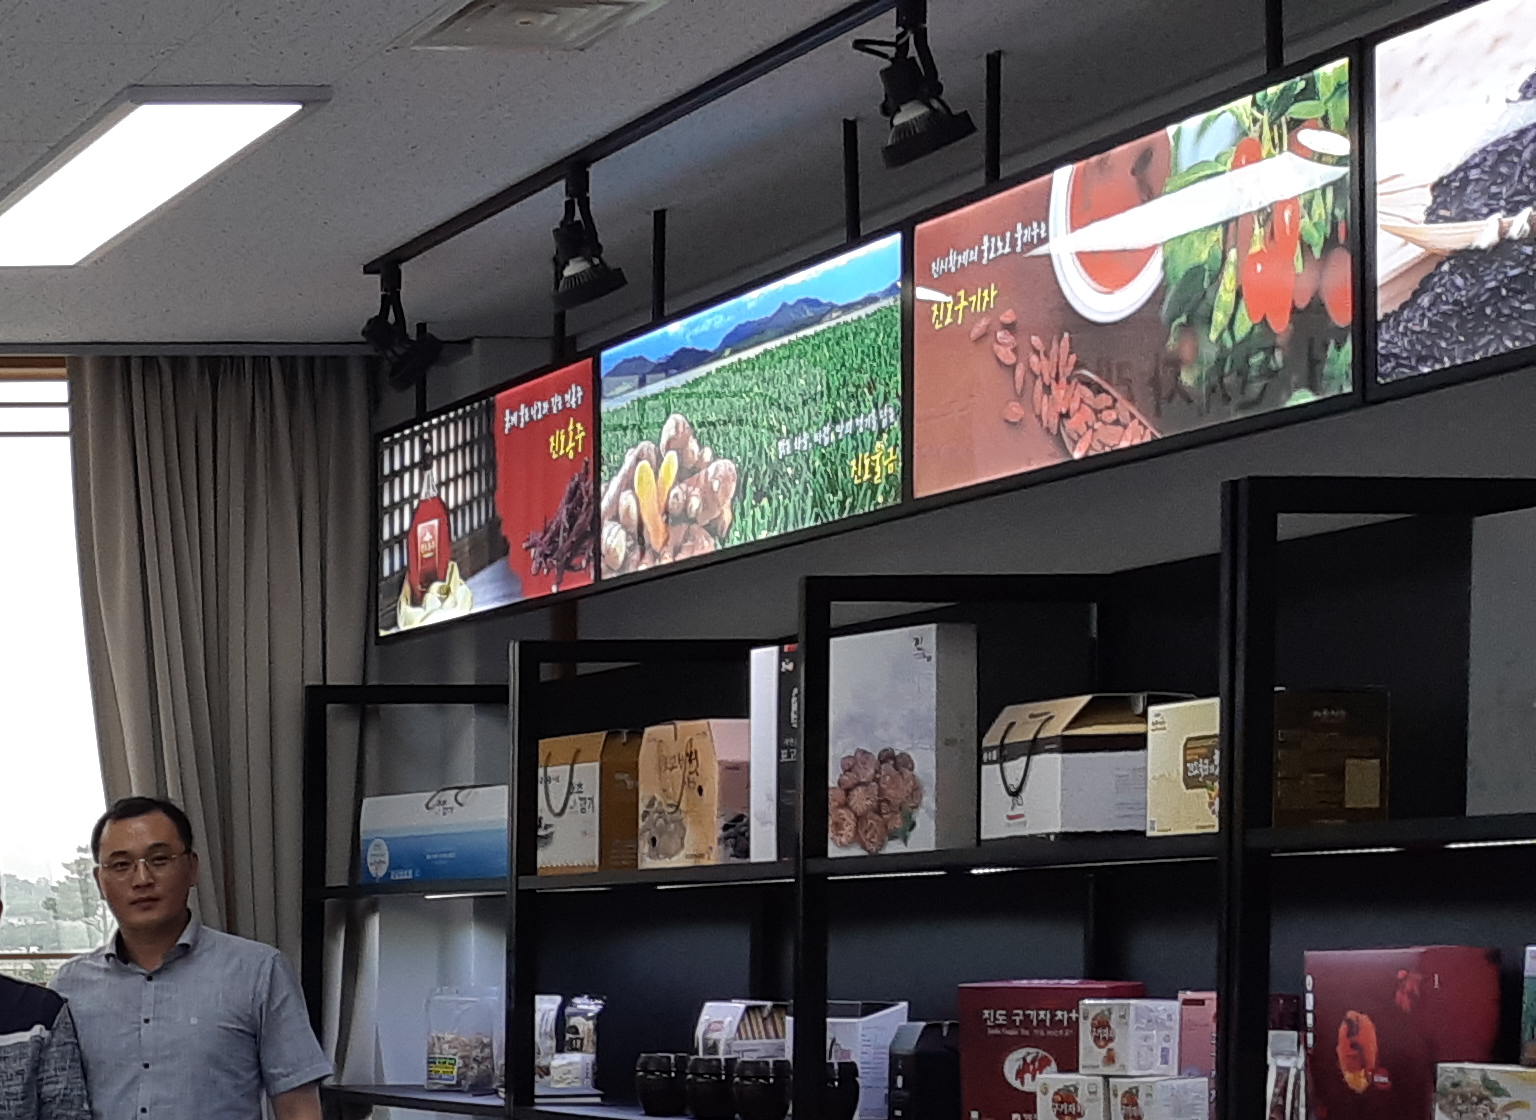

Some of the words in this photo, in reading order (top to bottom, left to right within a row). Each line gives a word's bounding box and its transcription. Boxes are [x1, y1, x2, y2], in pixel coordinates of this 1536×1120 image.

[549, 416, 586, 459] 진도홍주
[982, 1008, 1008, 1026] 진도
[1011, 1009, 1051, 1027] 구기자
